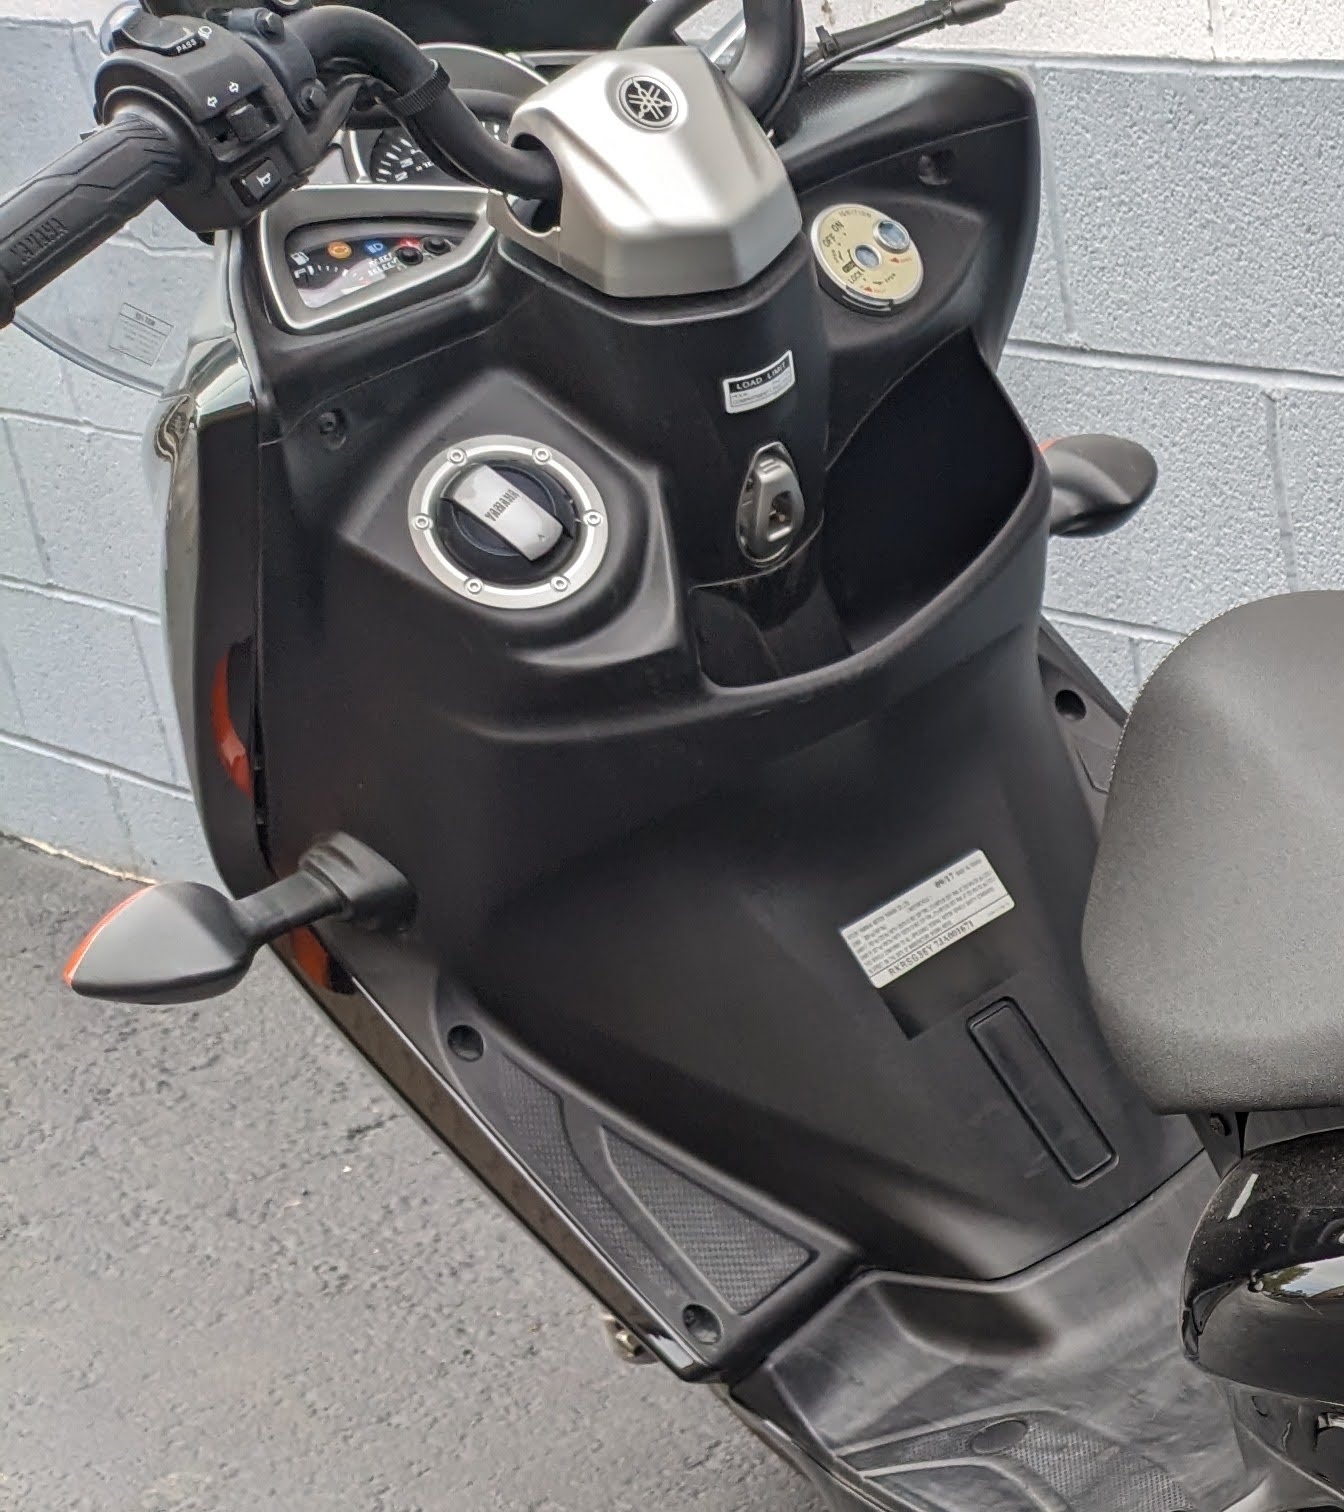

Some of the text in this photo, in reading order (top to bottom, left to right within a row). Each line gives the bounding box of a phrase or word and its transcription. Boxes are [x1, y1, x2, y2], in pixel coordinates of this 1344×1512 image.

[176, 38, 197, 53] PASS
[831, 221, 844, 232] ON
[822, 233, 836, 248] OFF
[736, 377, 763, 390] LOAD
[484, 489, 520, 522] YAMAHA
